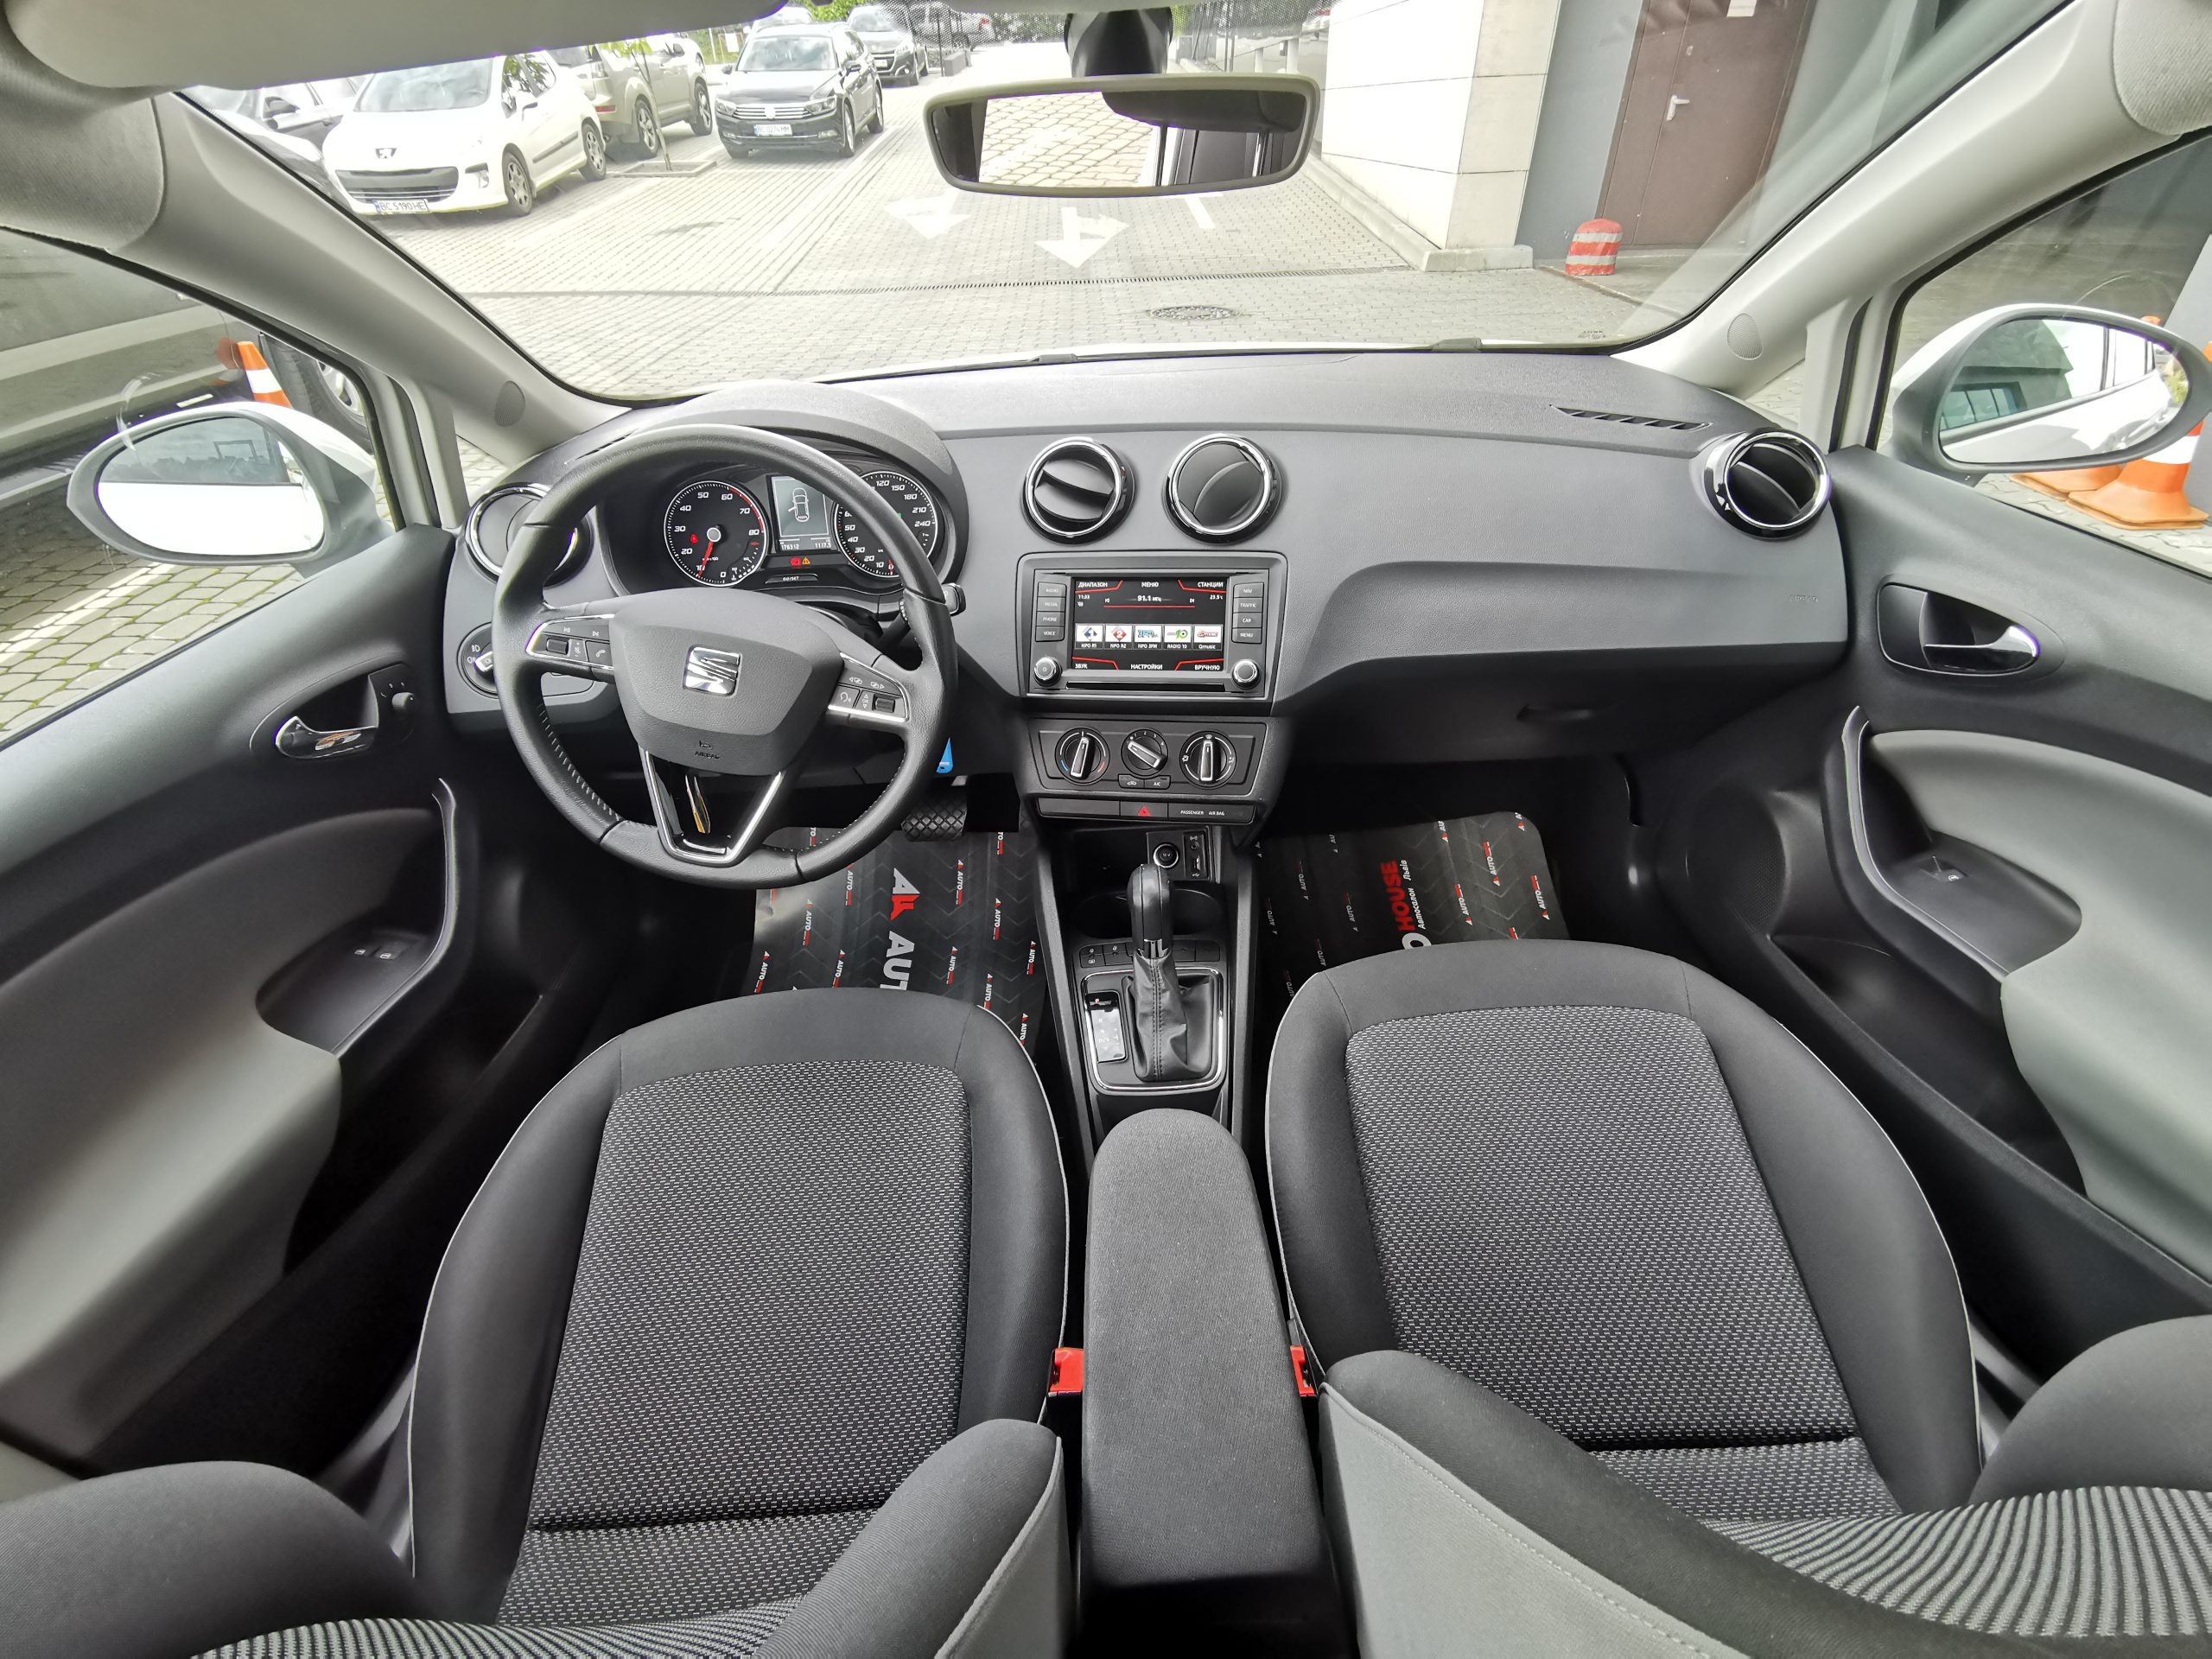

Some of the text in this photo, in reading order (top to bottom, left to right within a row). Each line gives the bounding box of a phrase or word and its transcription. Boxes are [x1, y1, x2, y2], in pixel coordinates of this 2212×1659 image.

[1487, 856, 1497, 875] AUTO
[1381, 861, 1415, 931] HOUSE
[1535, 890, 1546, 909] AUTO
[1346, 906, 1355, 922] AUTO
[1459, 898, 1469, 915] AUTO
[835, 960, 843, 977] AUTO
[880, 931, 915, 991] AUT
[759, 962, 768, 980] AUTO
